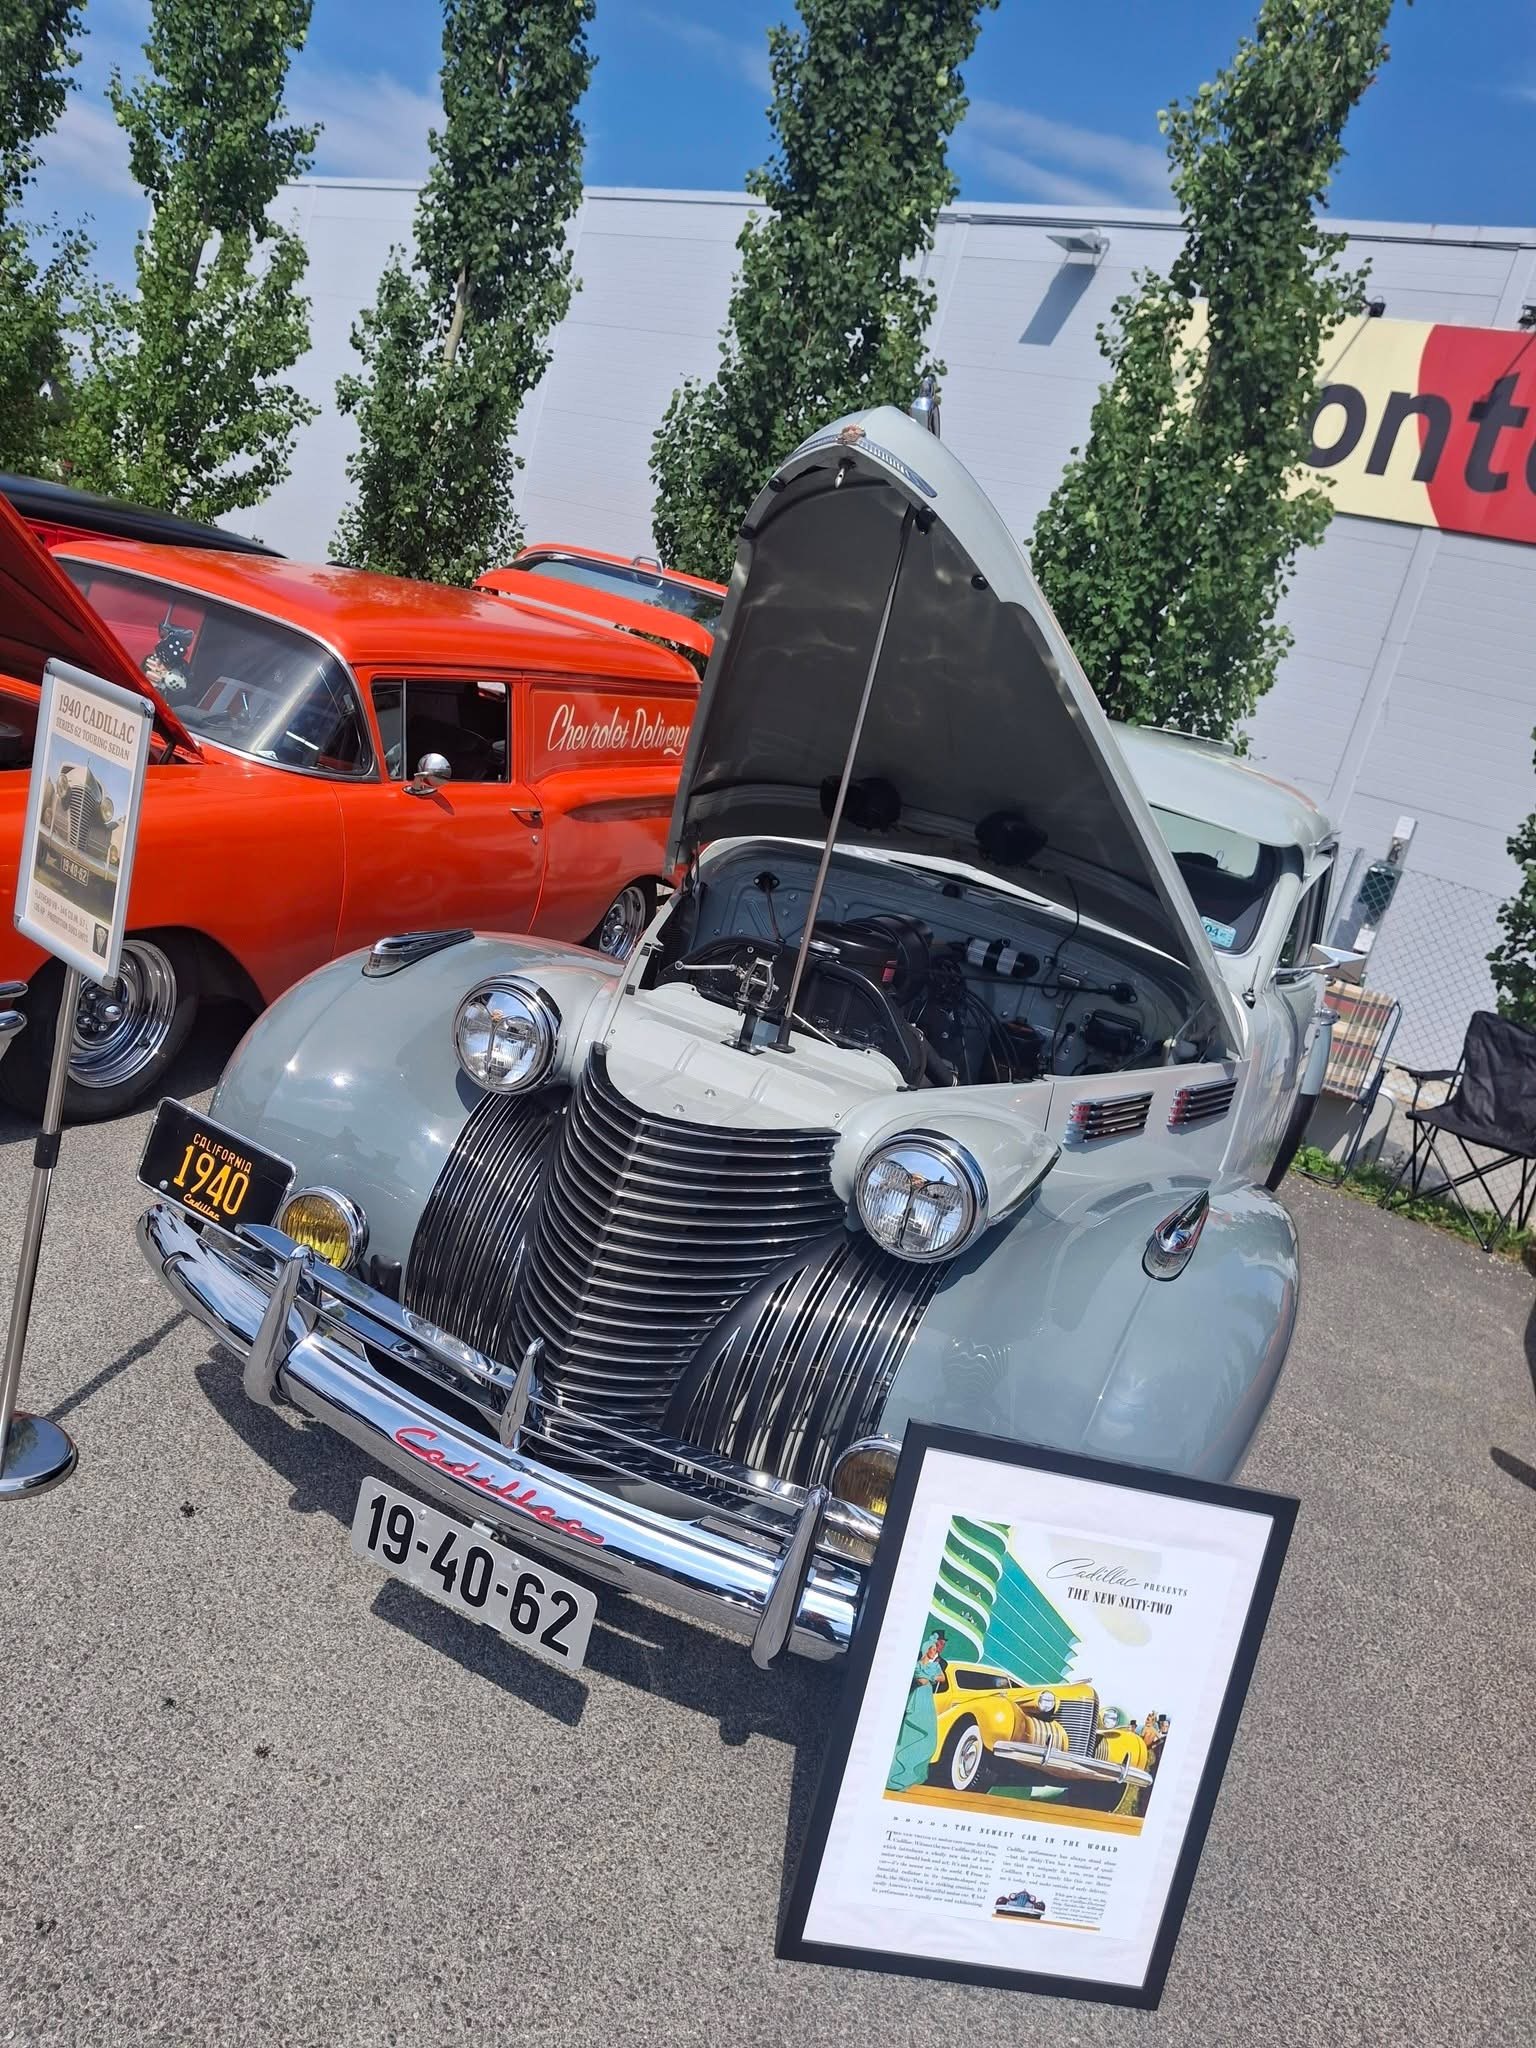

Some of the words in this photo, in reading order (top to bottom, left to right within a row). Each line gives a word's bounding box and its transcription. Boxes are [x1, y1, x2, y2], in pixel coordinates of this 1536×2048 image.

[1301, 372, 1536, 496] ont
[56, 717, 74, 734] SERIES
[74, 726, 81, 738] 62
[83, 729, 108, 750] TOURING
[108, 742, 130, 760] SEDAN
[59, 695, 81, 719] 1940
[83, 705, 134, 744] CADILLAC
[548, 704, 629, 751] Chevrolet
[632, 708, 690, 756] Delivery
[193, 1133, 252, 1174] CALIFORNIA
[173, 1145, 249, 1215] 1940
[183, 1194, 220, 1222] Cadillac
[394, 1427, 604, 1545] Cadillac
[368, 1494, 578, 1656] 19-40-62
[1046, 1558, 1140, 1586] Cadillac
[1144, 1582, 1188, 1596] PRESENTS
[1067, 1587, 1089, 1602] THE
[1092, 1590, 1117, 1606] NEW
[1119, 1596, 1172, 1616] SIXTY-TWO
[954, 1824, 972, 1833] THE
[979, 1828, 1014, 1839] NEWEST
[1021, 1834, 1038, 1842] CAR
[1063, 1840, 1080, 1848] THE
[1088, 1842, 1118, 1853] WORLD
